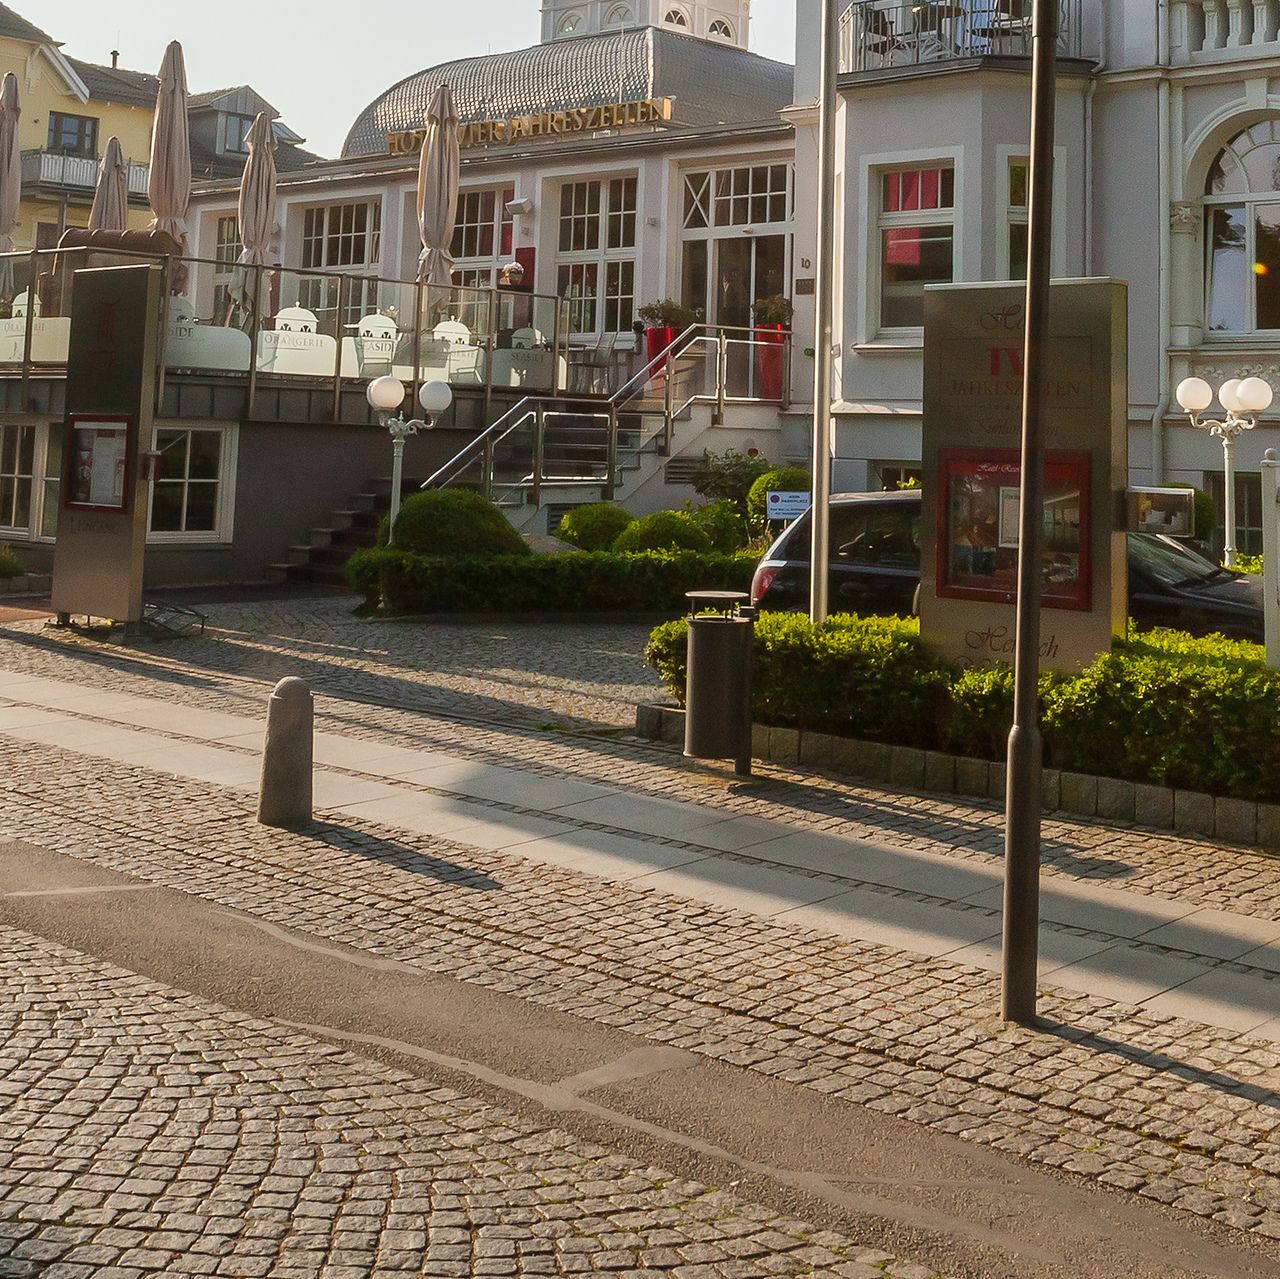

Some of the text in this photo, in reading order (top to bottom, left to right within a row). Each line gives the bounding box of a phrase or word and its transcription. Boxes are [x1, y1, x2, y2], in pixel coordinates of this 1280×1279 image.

[504, 96, 672, 148] JAHRESZEITEN
[800, 258, 811, 269] 10
[264, 333, 325, 348] ORANGERIE
